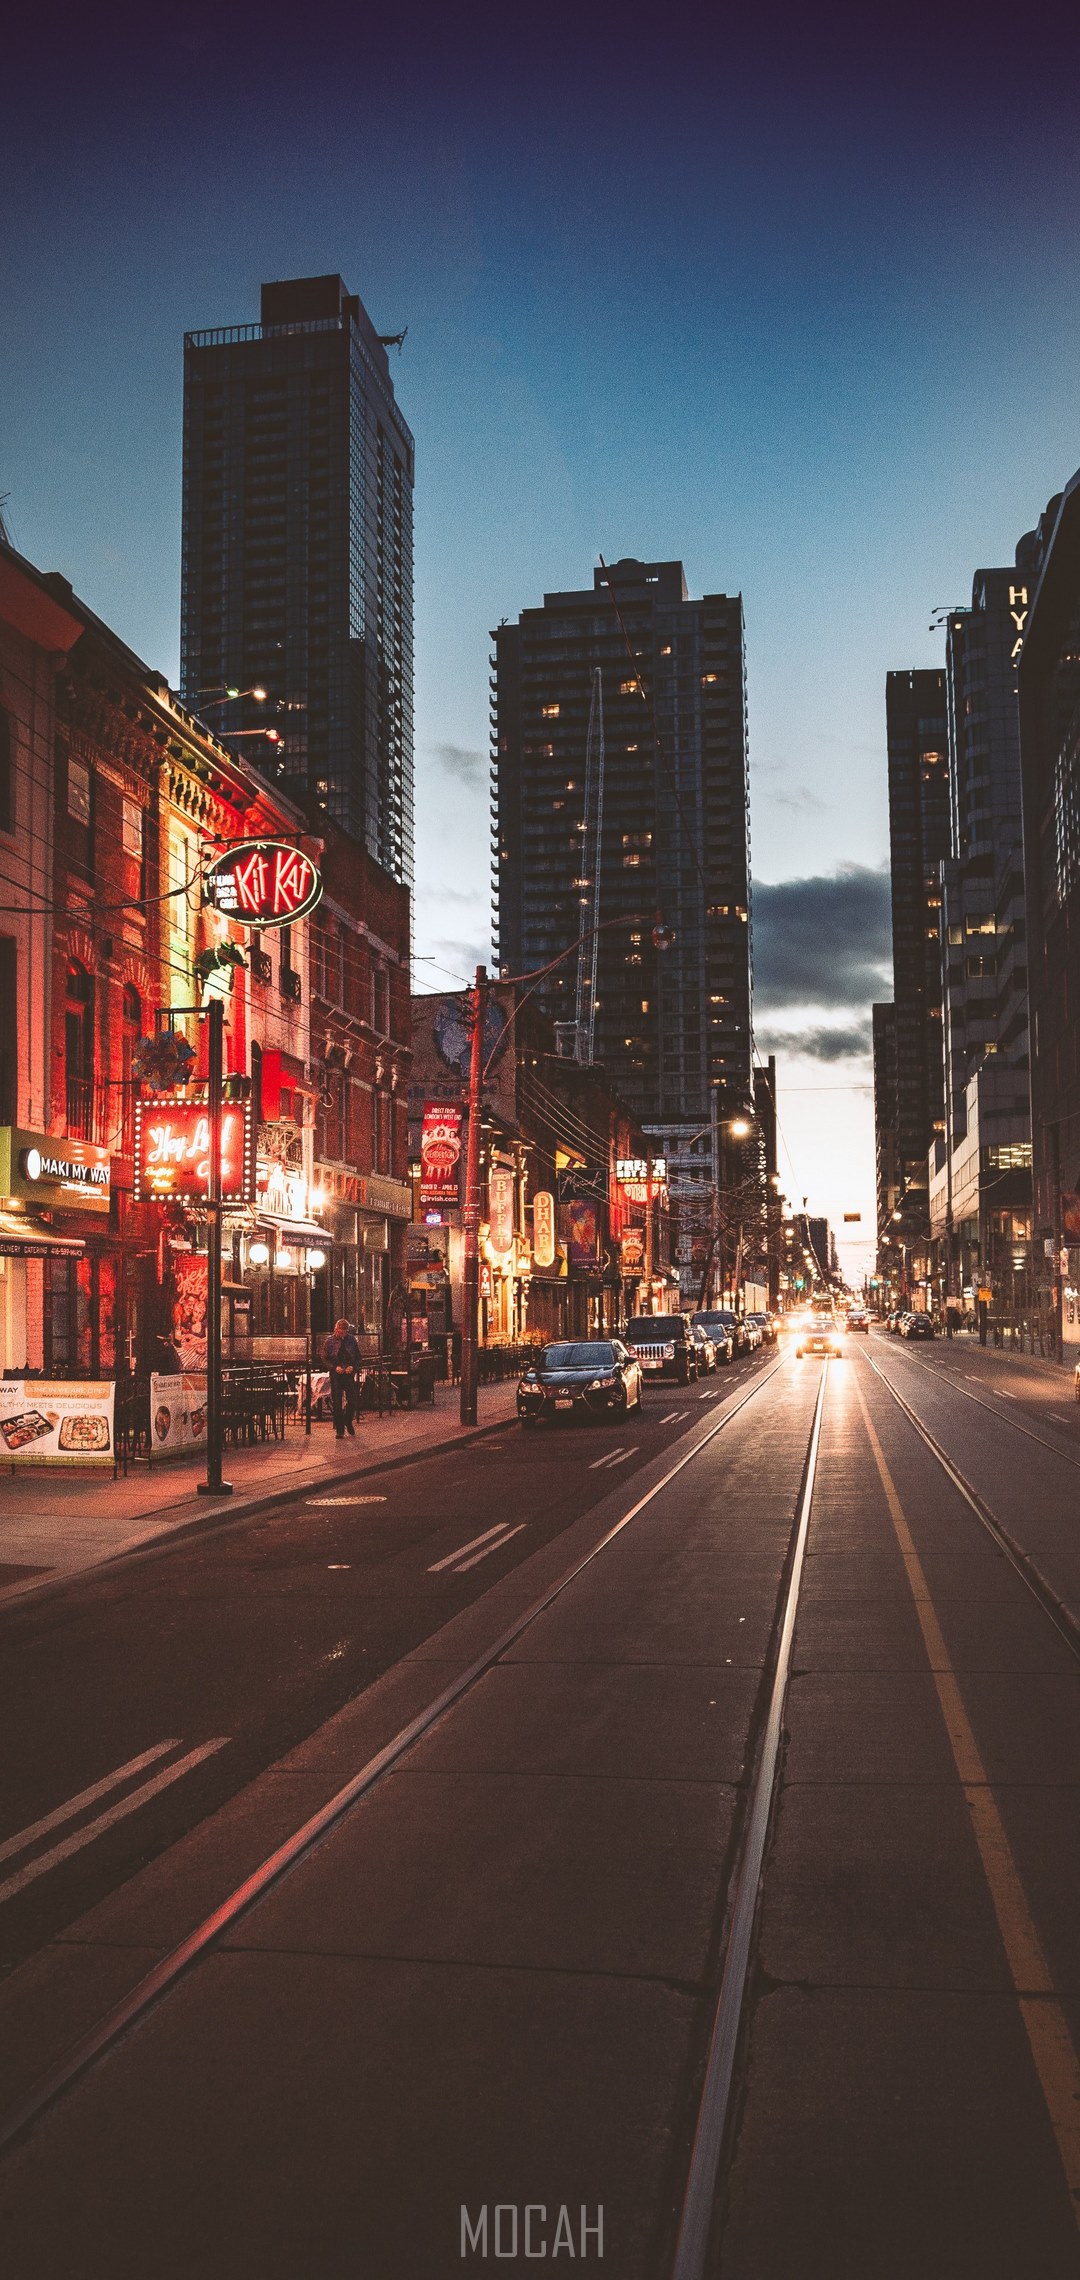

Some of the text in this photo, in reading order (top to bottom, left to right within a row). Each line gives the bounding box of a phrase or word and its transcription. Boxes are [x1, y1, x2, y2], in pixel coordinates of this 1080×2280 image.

[1009, 586, 1028, 692] HYA
[41, 1157, 110, 1184] MAKI MY WAY
[496, 1180, 507, 1247] BUFFET
